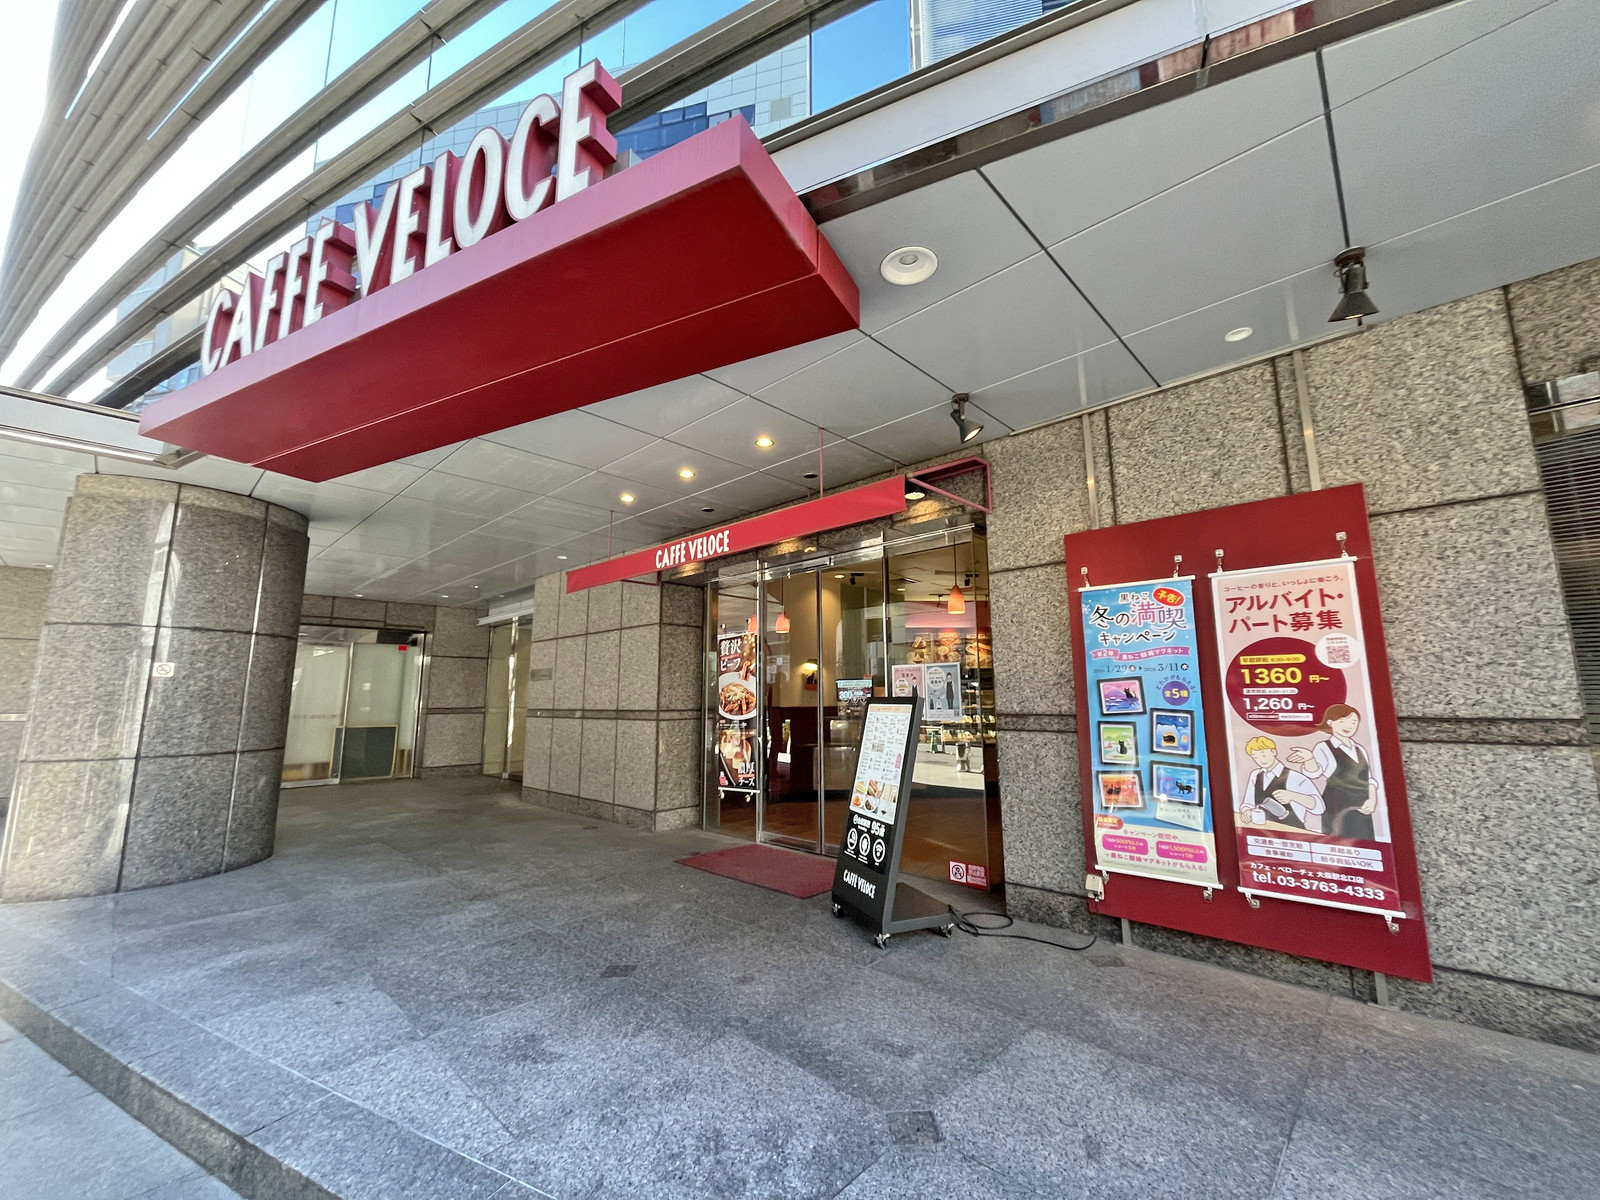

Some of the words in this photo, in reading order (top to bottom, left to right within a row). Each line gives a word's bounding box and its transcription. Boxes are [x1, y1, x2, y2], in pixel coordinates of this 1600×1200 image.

[353, 57, 612, 298] VELOCE
[688, 529, 730, 560] VELOCE
[1119, 592, 1149, 603] 黒ねこ
[1090, 601, 1187, 631] 冬の満喫
[1228, 610, 1343, 634] パート募集
[1099, 630, 1176, 646] キャンペーン
[720, 658, 741, 671] ビーフ
[1106, 664, 1127, 674] 1/29
[1157, 662, 1179, 672] 3/11
[1240, 667, 1302, 685] 1360
[1242, 697, 1293, 711] 1,260
[857, 876, 877, 899] VELOCE
